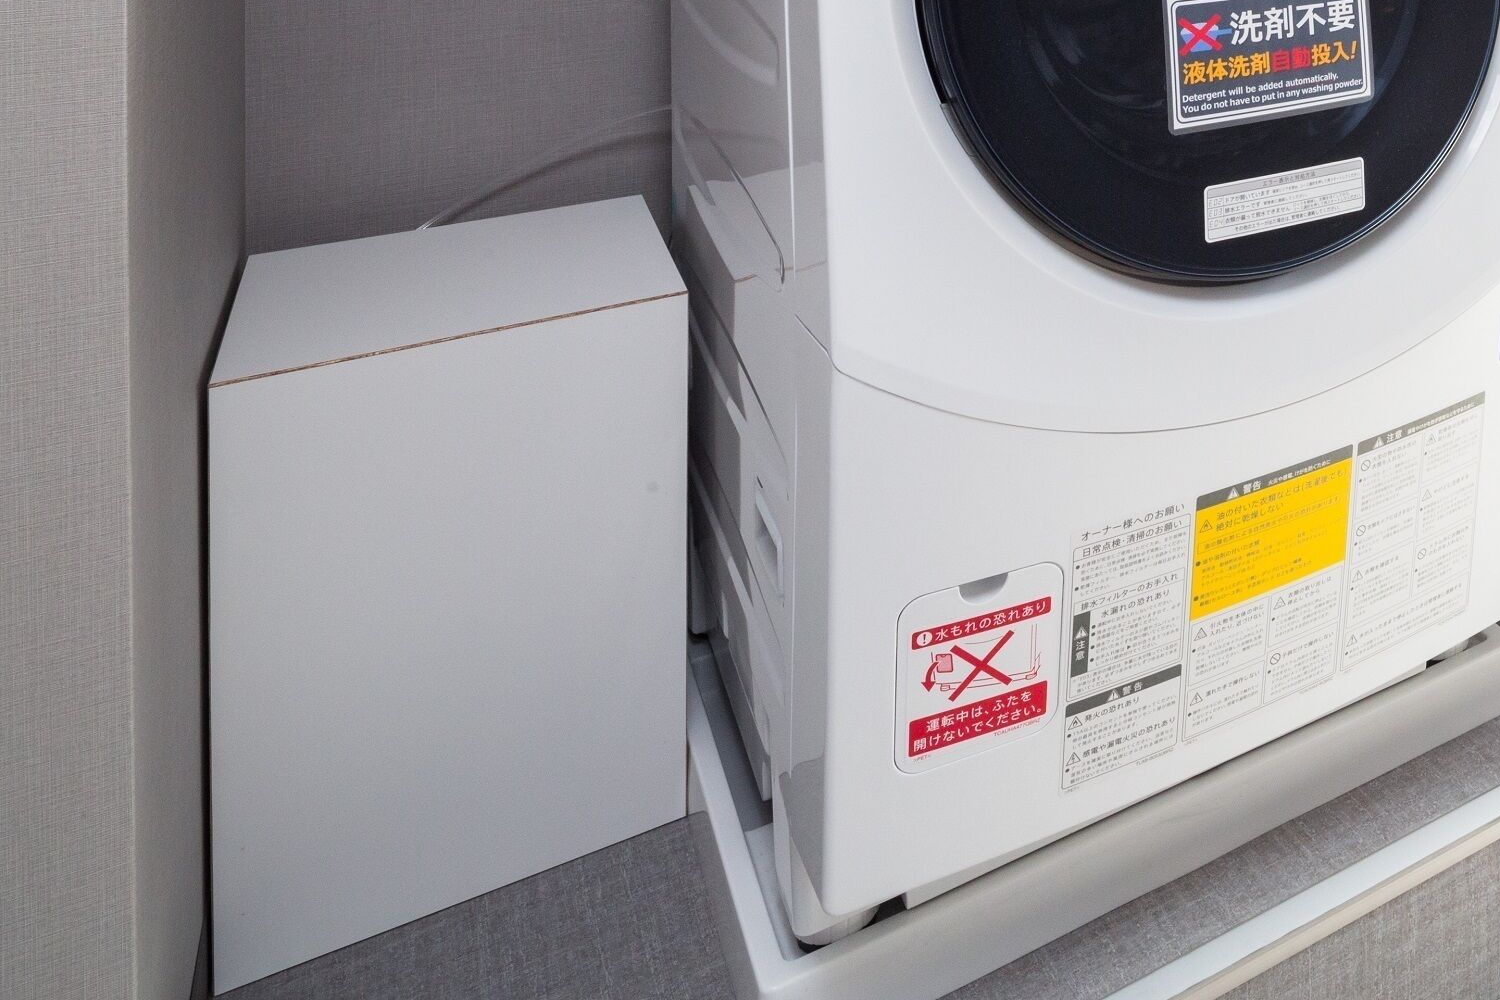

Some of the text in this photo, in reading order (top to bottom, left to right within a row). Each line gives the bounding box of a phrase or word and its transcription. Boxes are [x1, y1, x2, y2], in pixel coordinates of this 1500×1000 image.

[1182, 40, 1358, 86] 液体洗剤自動投入!
[1182, 72, 1339, 104] Detergent will be added automatically.
[1182, 78, 1364, 115] You do not have to put in any washing powder.
[1386, 430, 1403, 443] 注意
[1241, 480, 1262, 496] 警告
[1080, 502, 1186, 542] オーナー様へのお願い
[1082, 519, 1183, 558] 日常点検・清掃のお願い
[935, 601, 1047, 642] 水もれの恐れあり
[1101, 590, 1170, 619] 水漏れの恐れあり
[1076, 640, 1086, 661] 注意
[1122, 682, 1144, 696] 警告
[913, 706, 1042, 753] 開けないでください。
[926, 691, 1032, 733] 運転中は、ふたを
